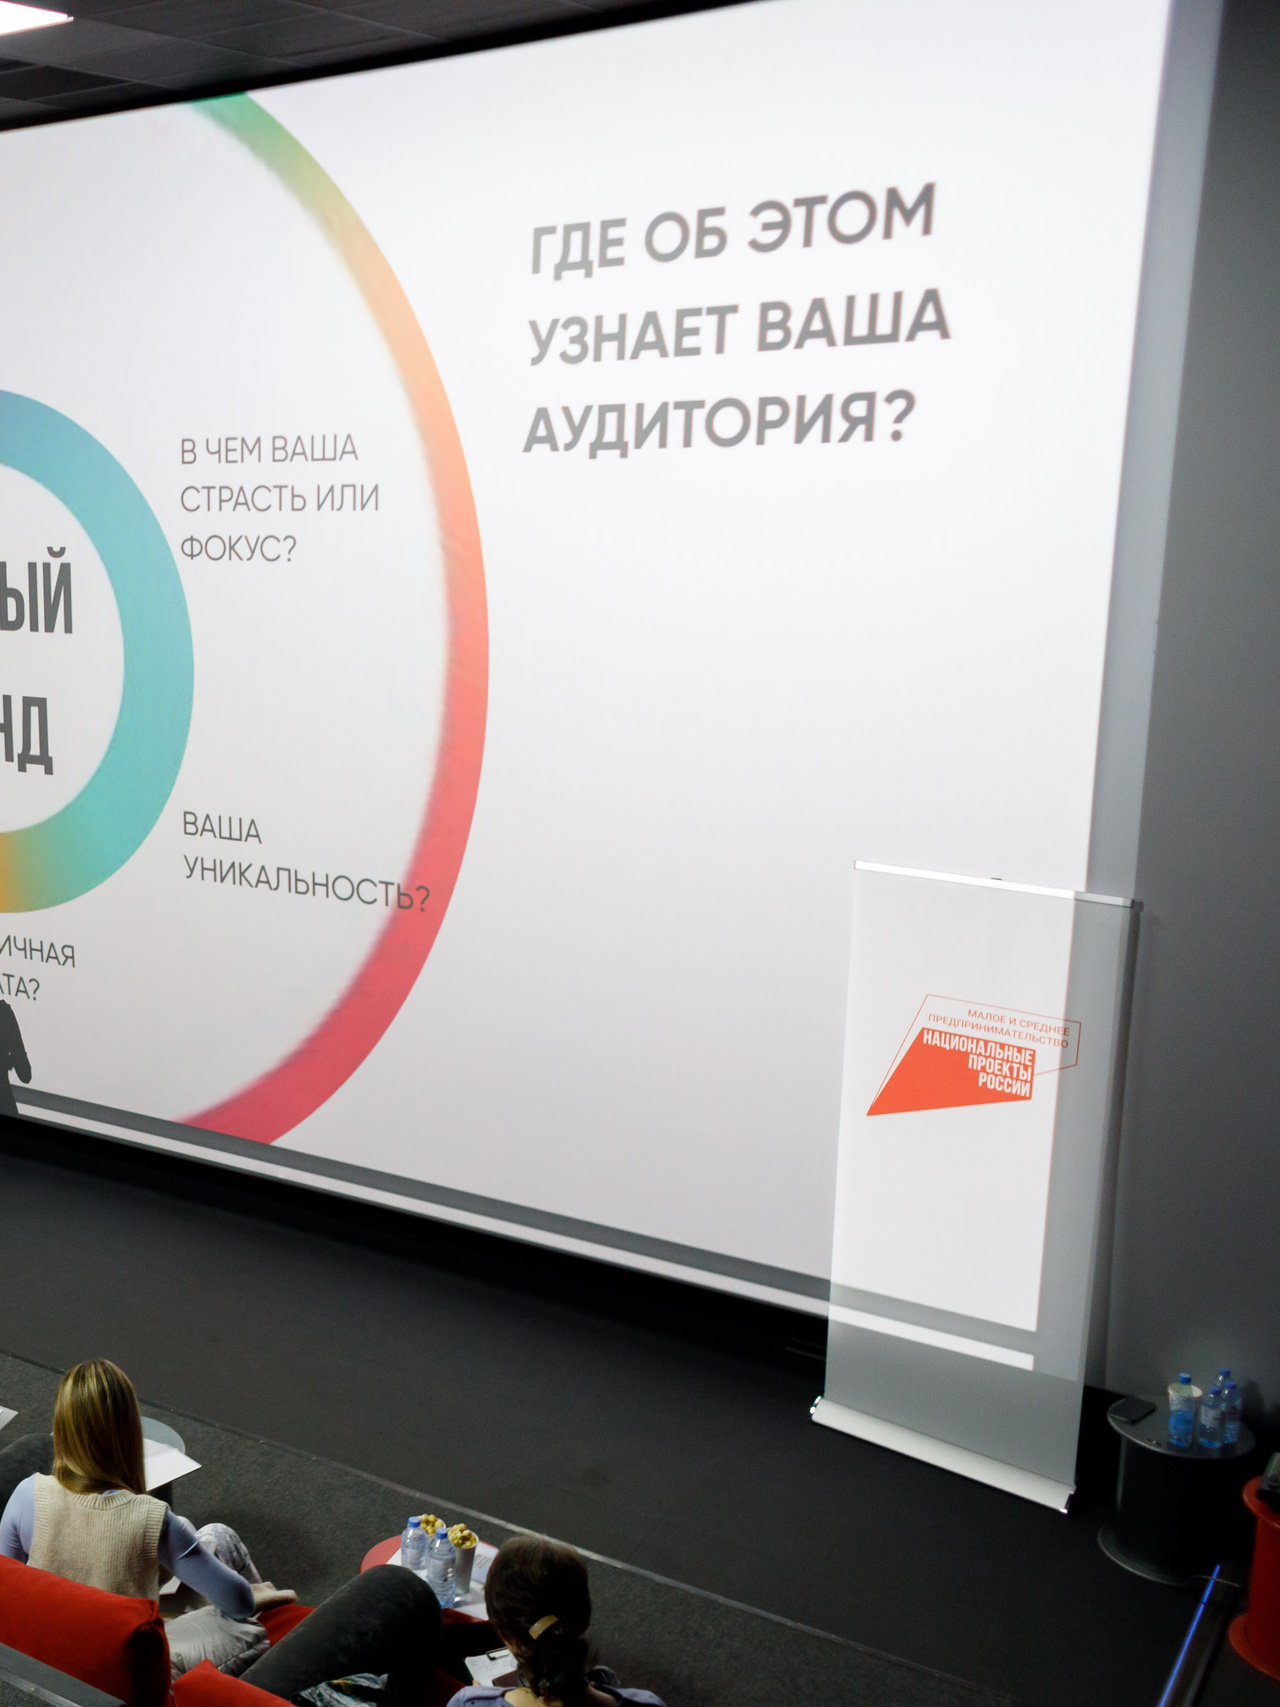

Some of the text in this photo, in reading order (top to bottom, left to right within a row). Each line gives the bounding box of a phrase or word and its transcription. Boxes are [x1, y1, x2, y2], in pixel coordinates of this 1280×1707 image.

[531, 182, 936, 281] ГДЕ ОБ ЭТОМ
[528, 288, 951, 366] УЗНАЕТ ВАША
[522, 388, 916, 460] АУДИТОРИЯ?
[181, 433, 359, 465] В ЧЕМ ВАША
[180, 483, 379, 513] СТРАСТЬ ИЛИ
[180, 534, 297, 562] ФОКУС?
[183, 810, 263, 845] ВАША
[183, 854, 431, 913] УНИКАЛЬНОСТЬ?
[928, 1013, 1069, 1049] ПРЕДПРИНИМАТЕЛЬСТВО
[967, 1008, 1070, 1037] МАЛОЕ И СРЕДНЕЕ
[922, 1028, 1033, 1066] НАЦИОНАЛЬНЫЕ
[968, 1054, 1032, 1082] ПРОЕКТЫ
[978, 1074, 1030, 1098] РОССИИ
